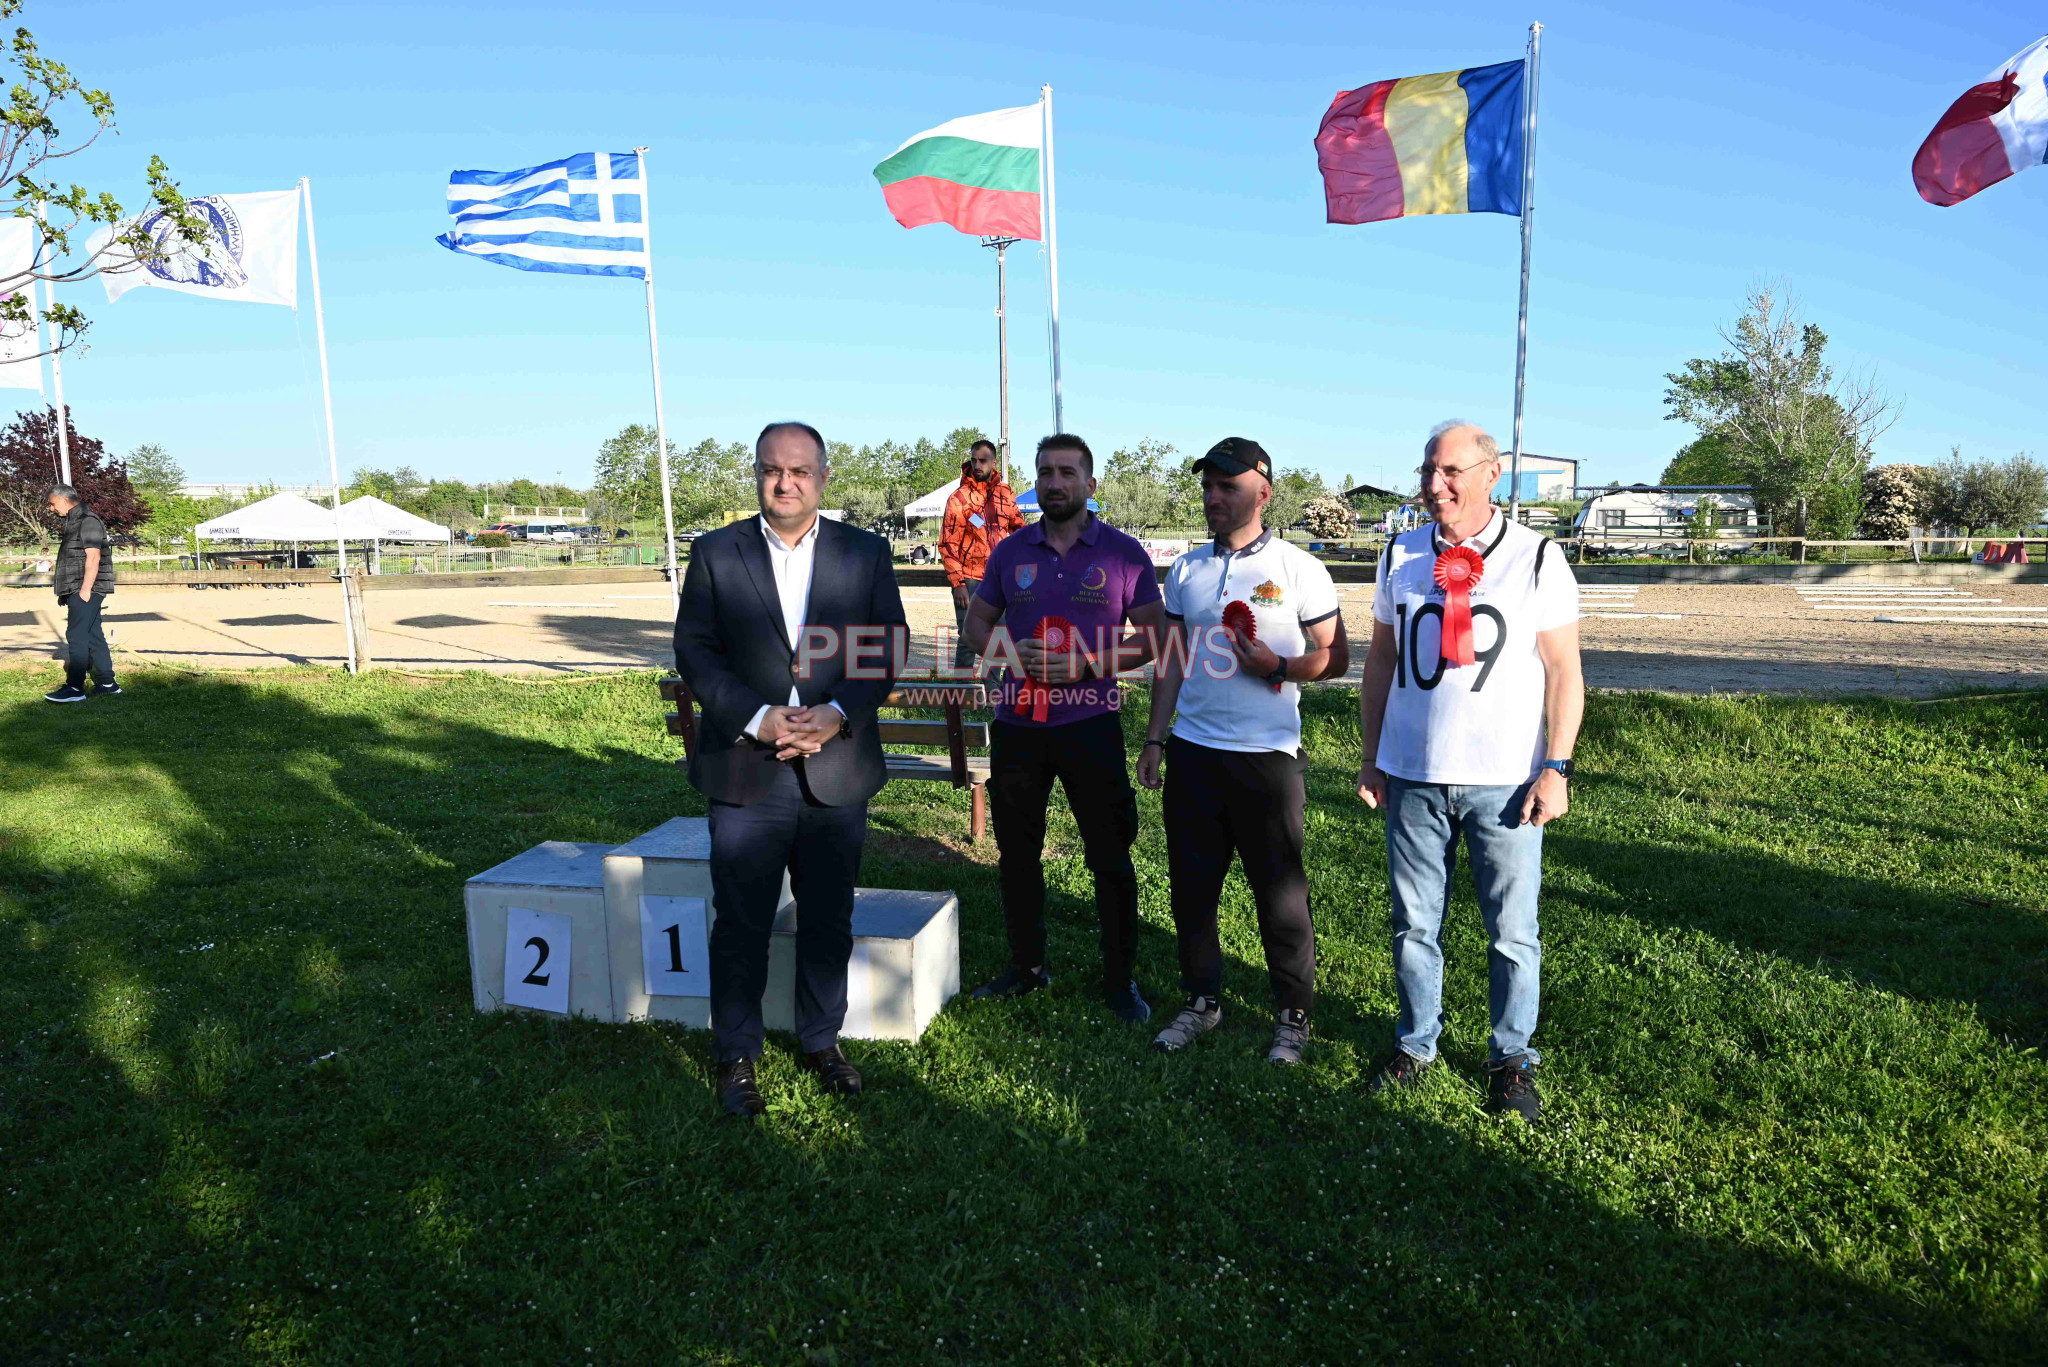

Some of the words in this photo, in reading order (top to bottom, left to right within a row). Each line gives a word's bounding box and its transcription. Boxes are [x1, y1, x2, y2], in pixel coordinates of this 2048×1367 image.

[1396, 602, 1507, 692] 109
[522, 936, 550, 986] 2
[662, 923, 689, 973] 1
